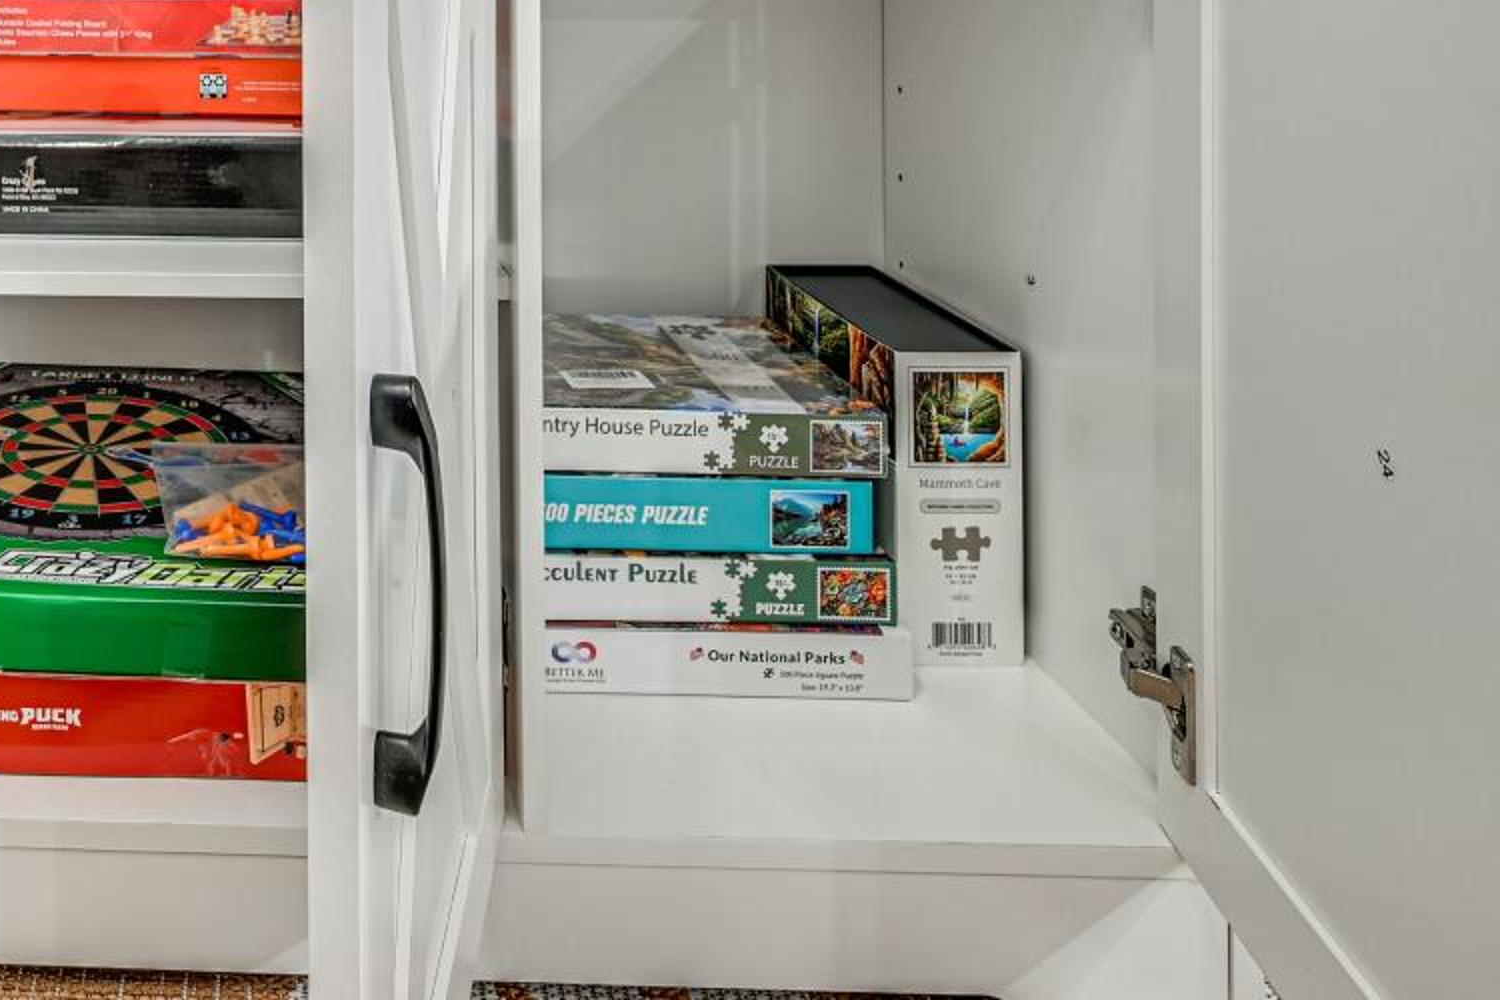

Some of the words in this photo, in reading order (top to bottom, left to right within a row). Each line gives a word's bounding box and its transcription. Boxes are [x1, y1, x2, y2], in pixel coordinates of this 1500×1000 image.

[97, 388, 117, 396] 20
[585, 417, 644, 435] House
[650, 420, 709, 437] Puzzle
[749, 455, 799, 469] PUZZLE
[920, 478, 972, 489] Mammoth
[976, 478, 1001, 489] Cave
[8, 508, 36, 520] 19
[121, 513, 147, 525] 17
[544, 503, 570, 523] 00
[574, 504, 638, 524] PIECES
[642, 505, 709, 526] PUZZLE
[755, 602, 805, 616] PUZZLE
[707, 649, 736, 663] Our
[739, 650, 802, 663] National
[804, 651, 846, 665] Parks
[19, 707, 82, 729] PUCK
